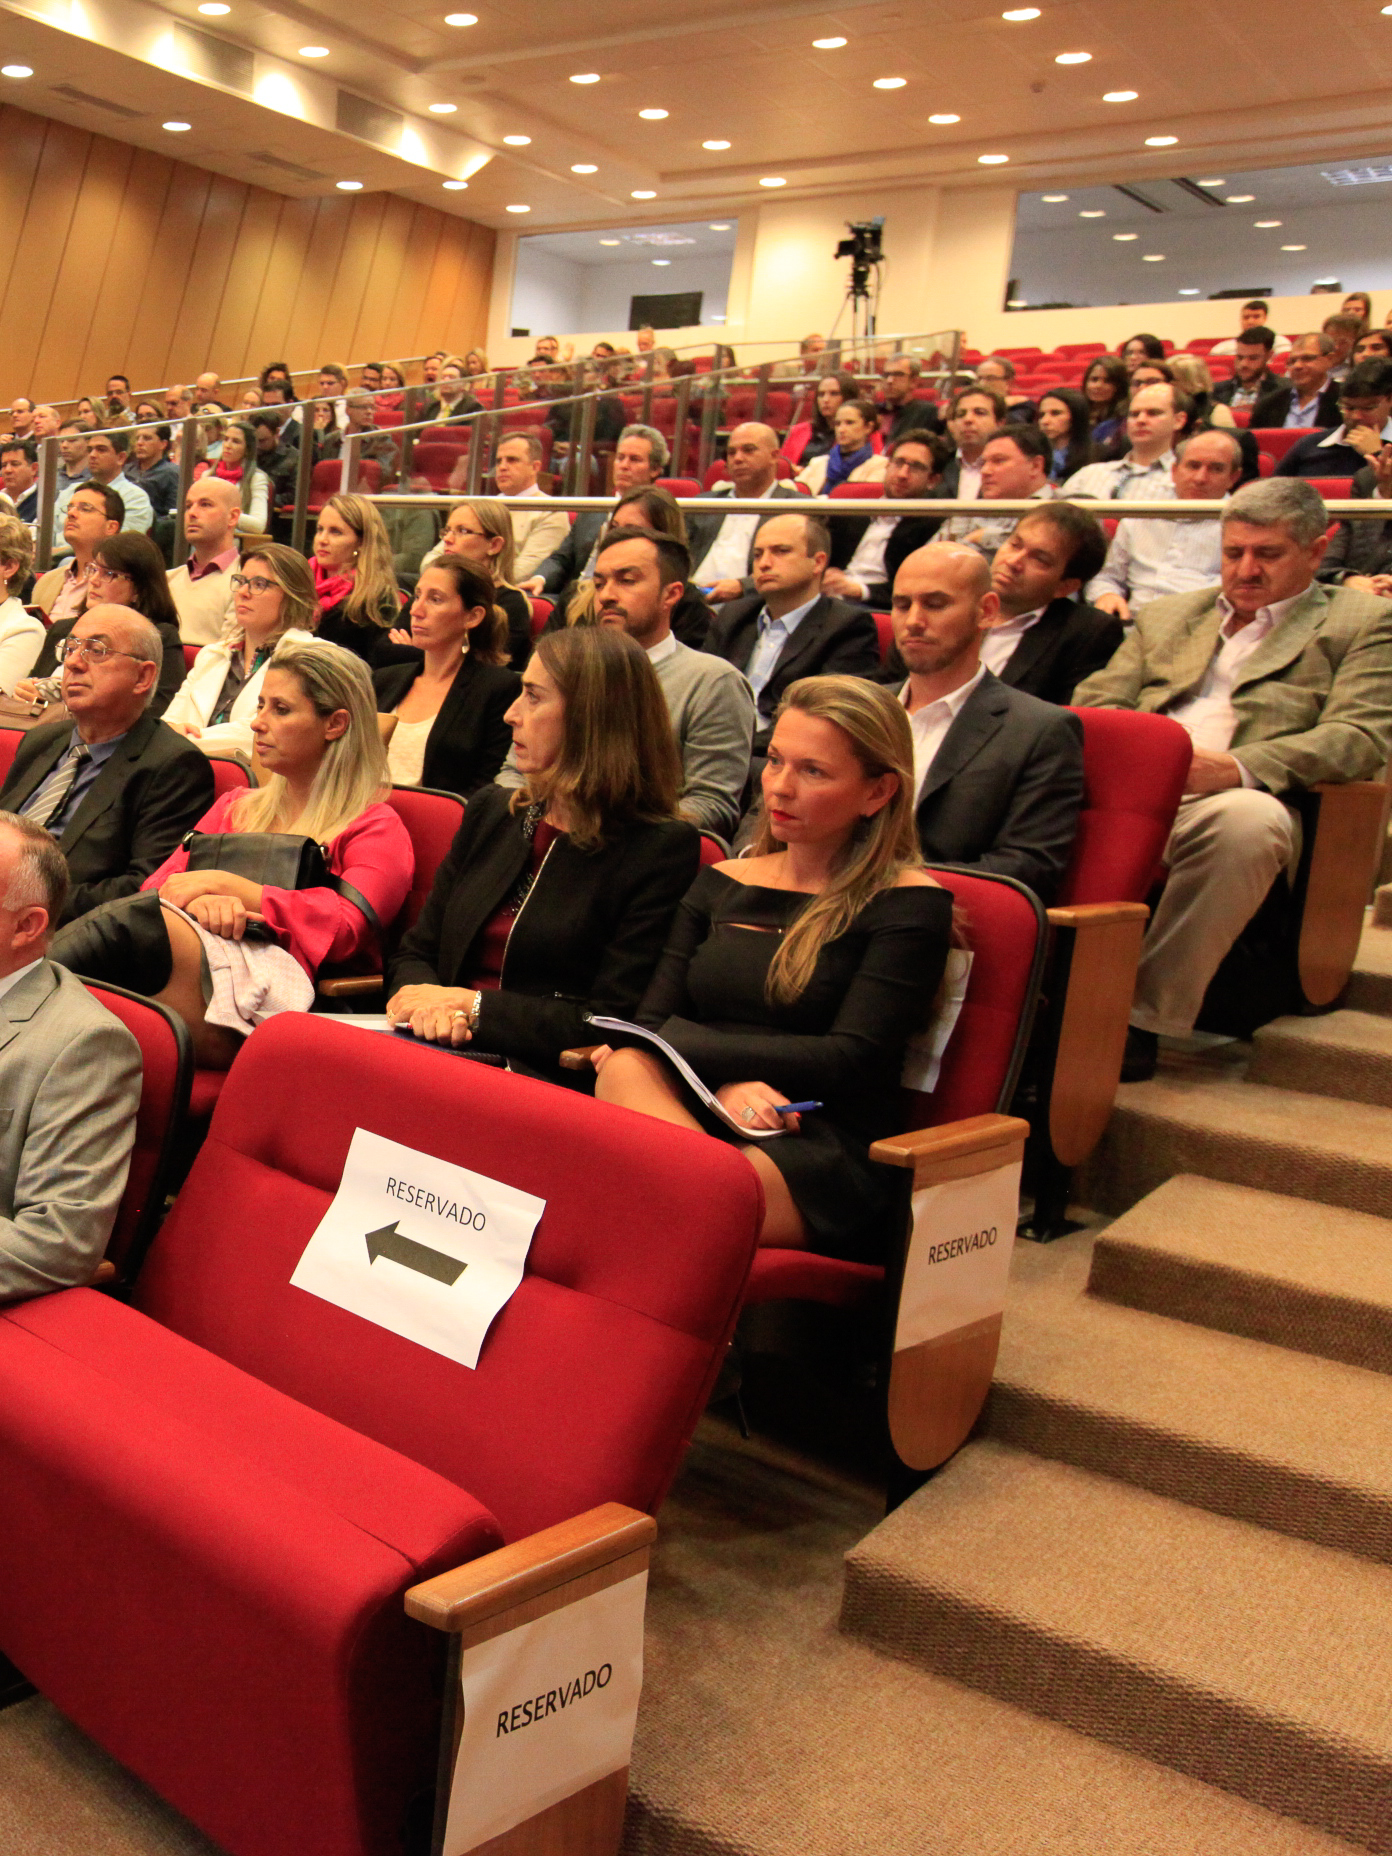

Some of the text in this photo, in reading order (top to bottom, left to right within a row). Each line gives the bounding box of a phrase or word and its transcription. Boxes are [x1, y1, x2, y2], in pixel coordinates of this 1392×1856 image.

[385, 1176, 487, 1232] RESERVADO
[927, 1226, 998, 1266] RESERVADO
[495, 1662, 613, 1739] RESERVADO
